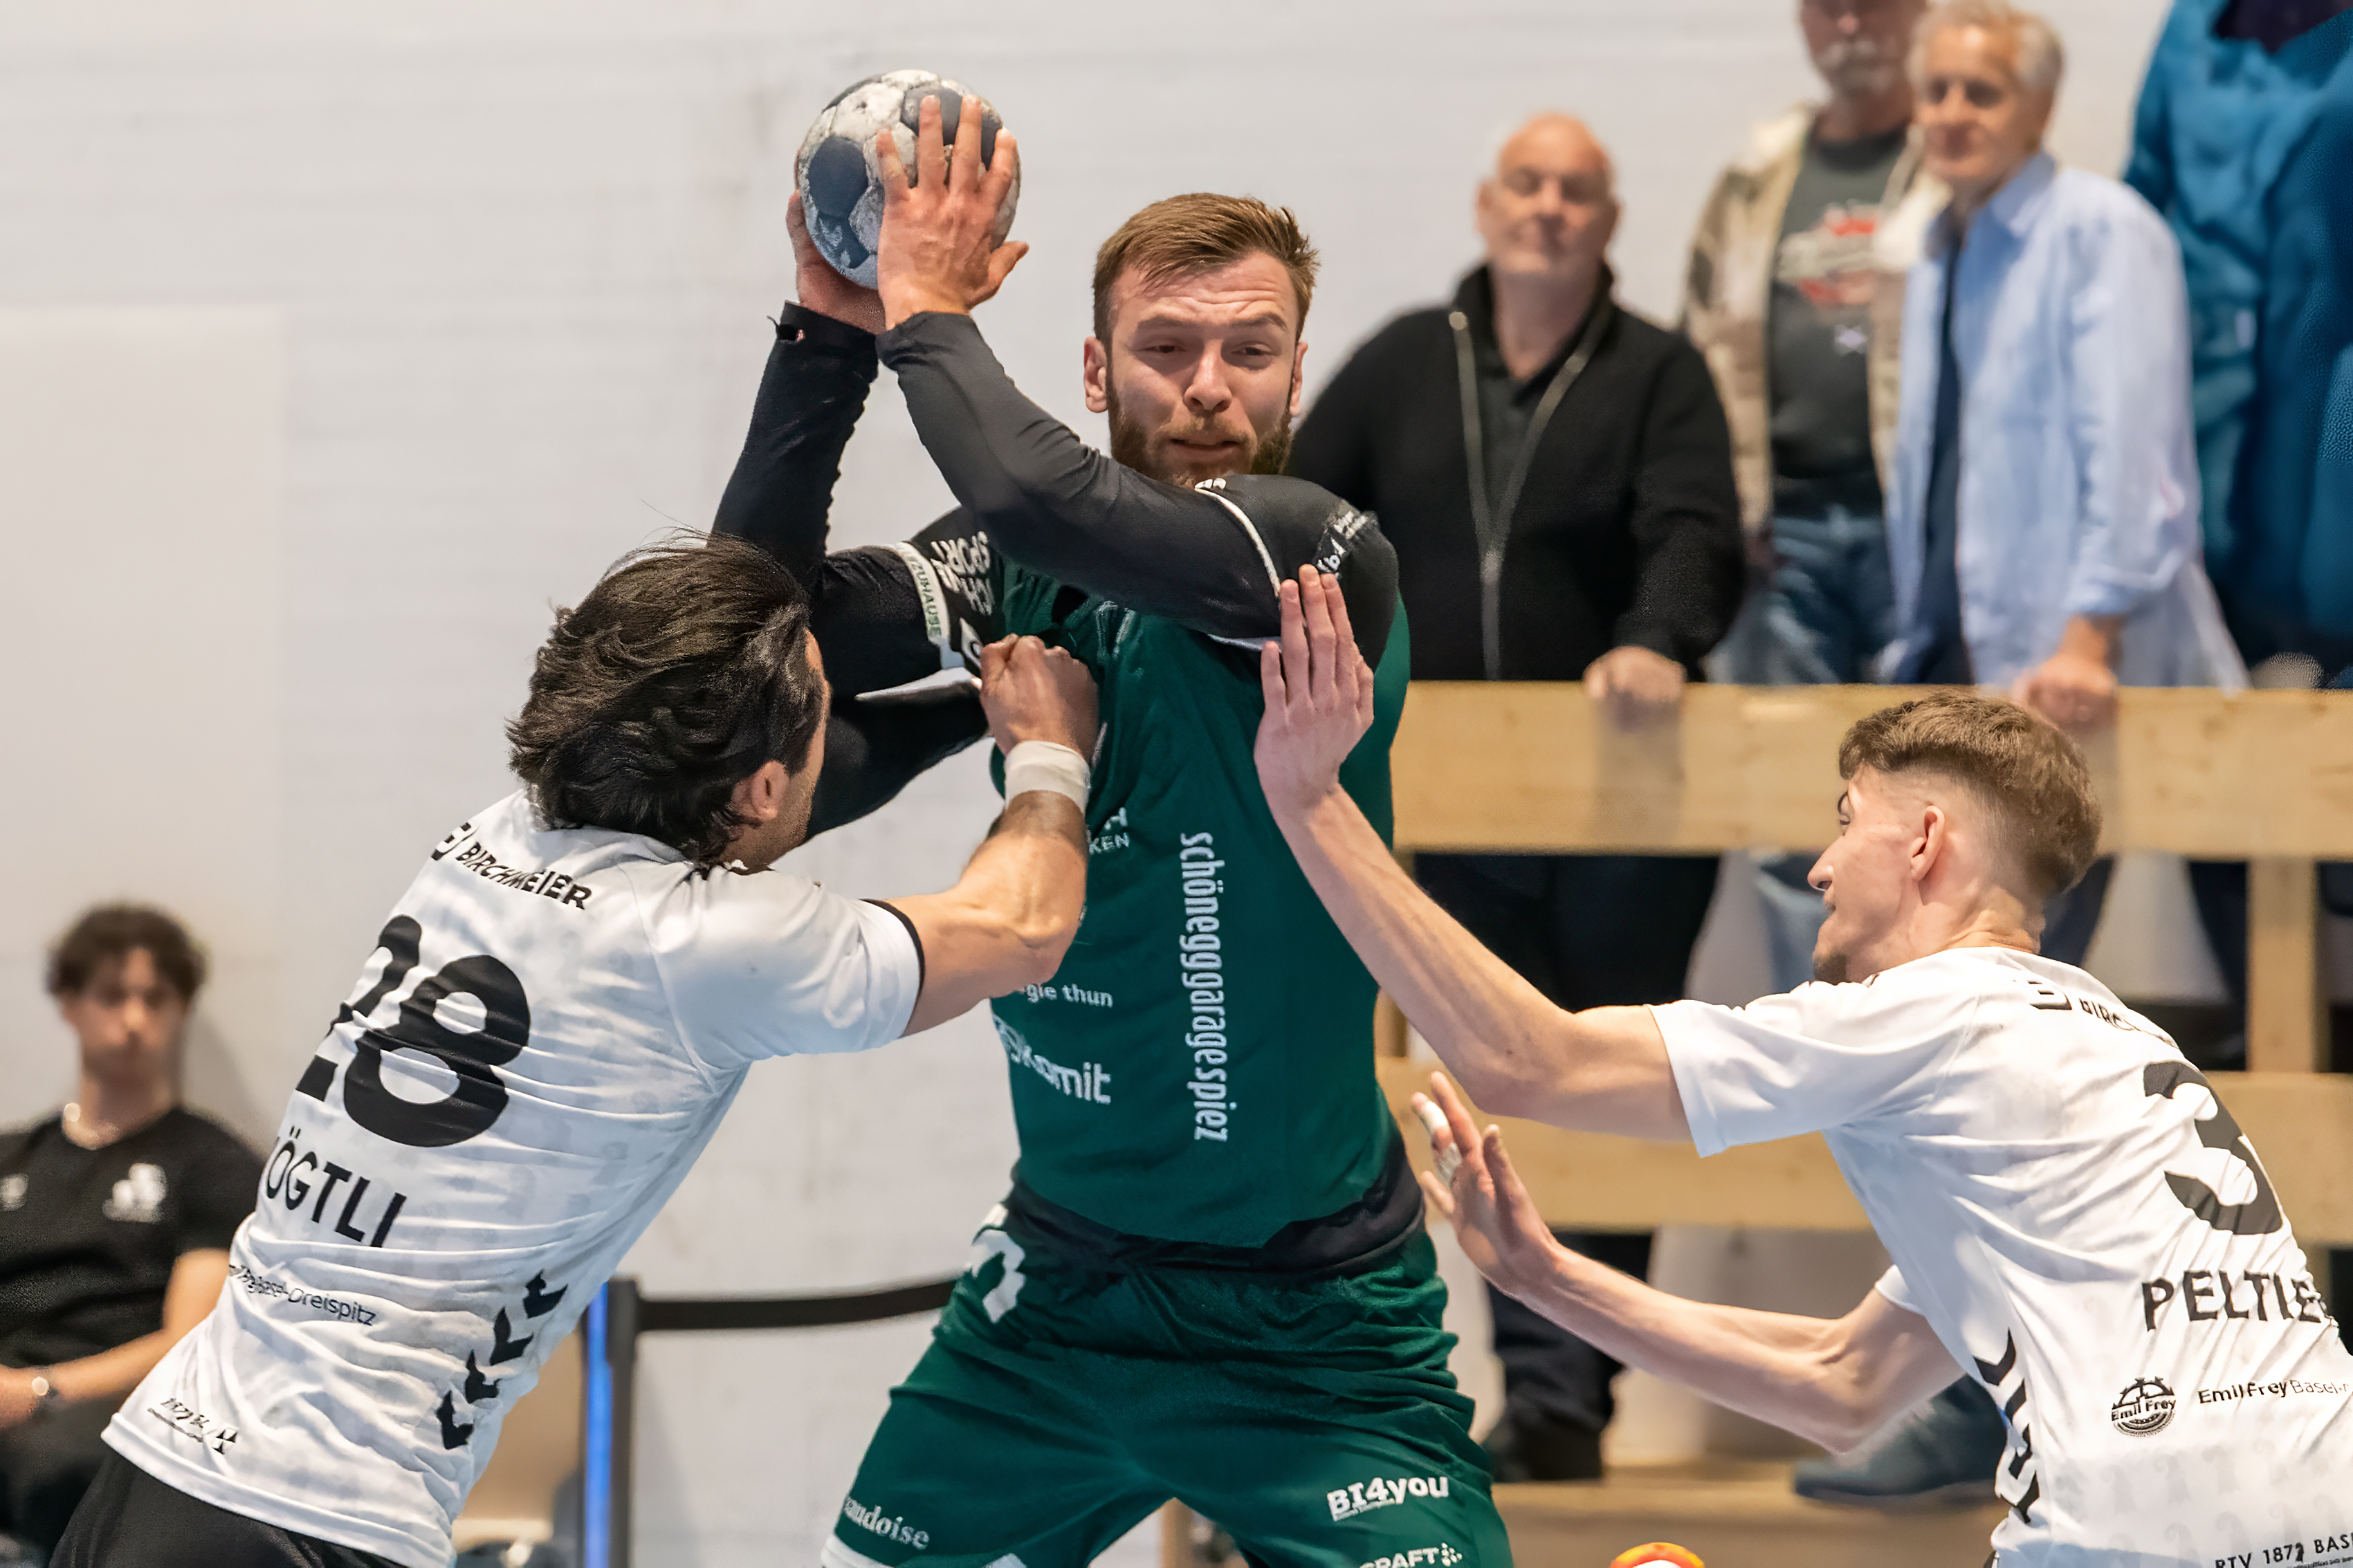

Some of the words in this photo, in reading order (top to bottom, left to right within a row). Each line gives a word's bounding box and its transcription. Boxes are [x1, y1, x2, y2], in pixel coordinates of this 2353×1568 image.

[1089, 832, 1130, 855] KEN
[1027, 983, 1058, 1004] gie
[1062, 983, 1114, 1008] thun
[295, 914, 531, 1147] 28
[266, 1125, 408, 1248] ÖGTLI
[2142, 1270, 2333, 1332] PELTIE
[2111, 1402, 2142, 1422] Emil
[2145, 1399, 2177, 1412] Frey
[1327, 1476, 1449, 1515] BI4you
[2314, 1531, 2353, 1554] BAS
